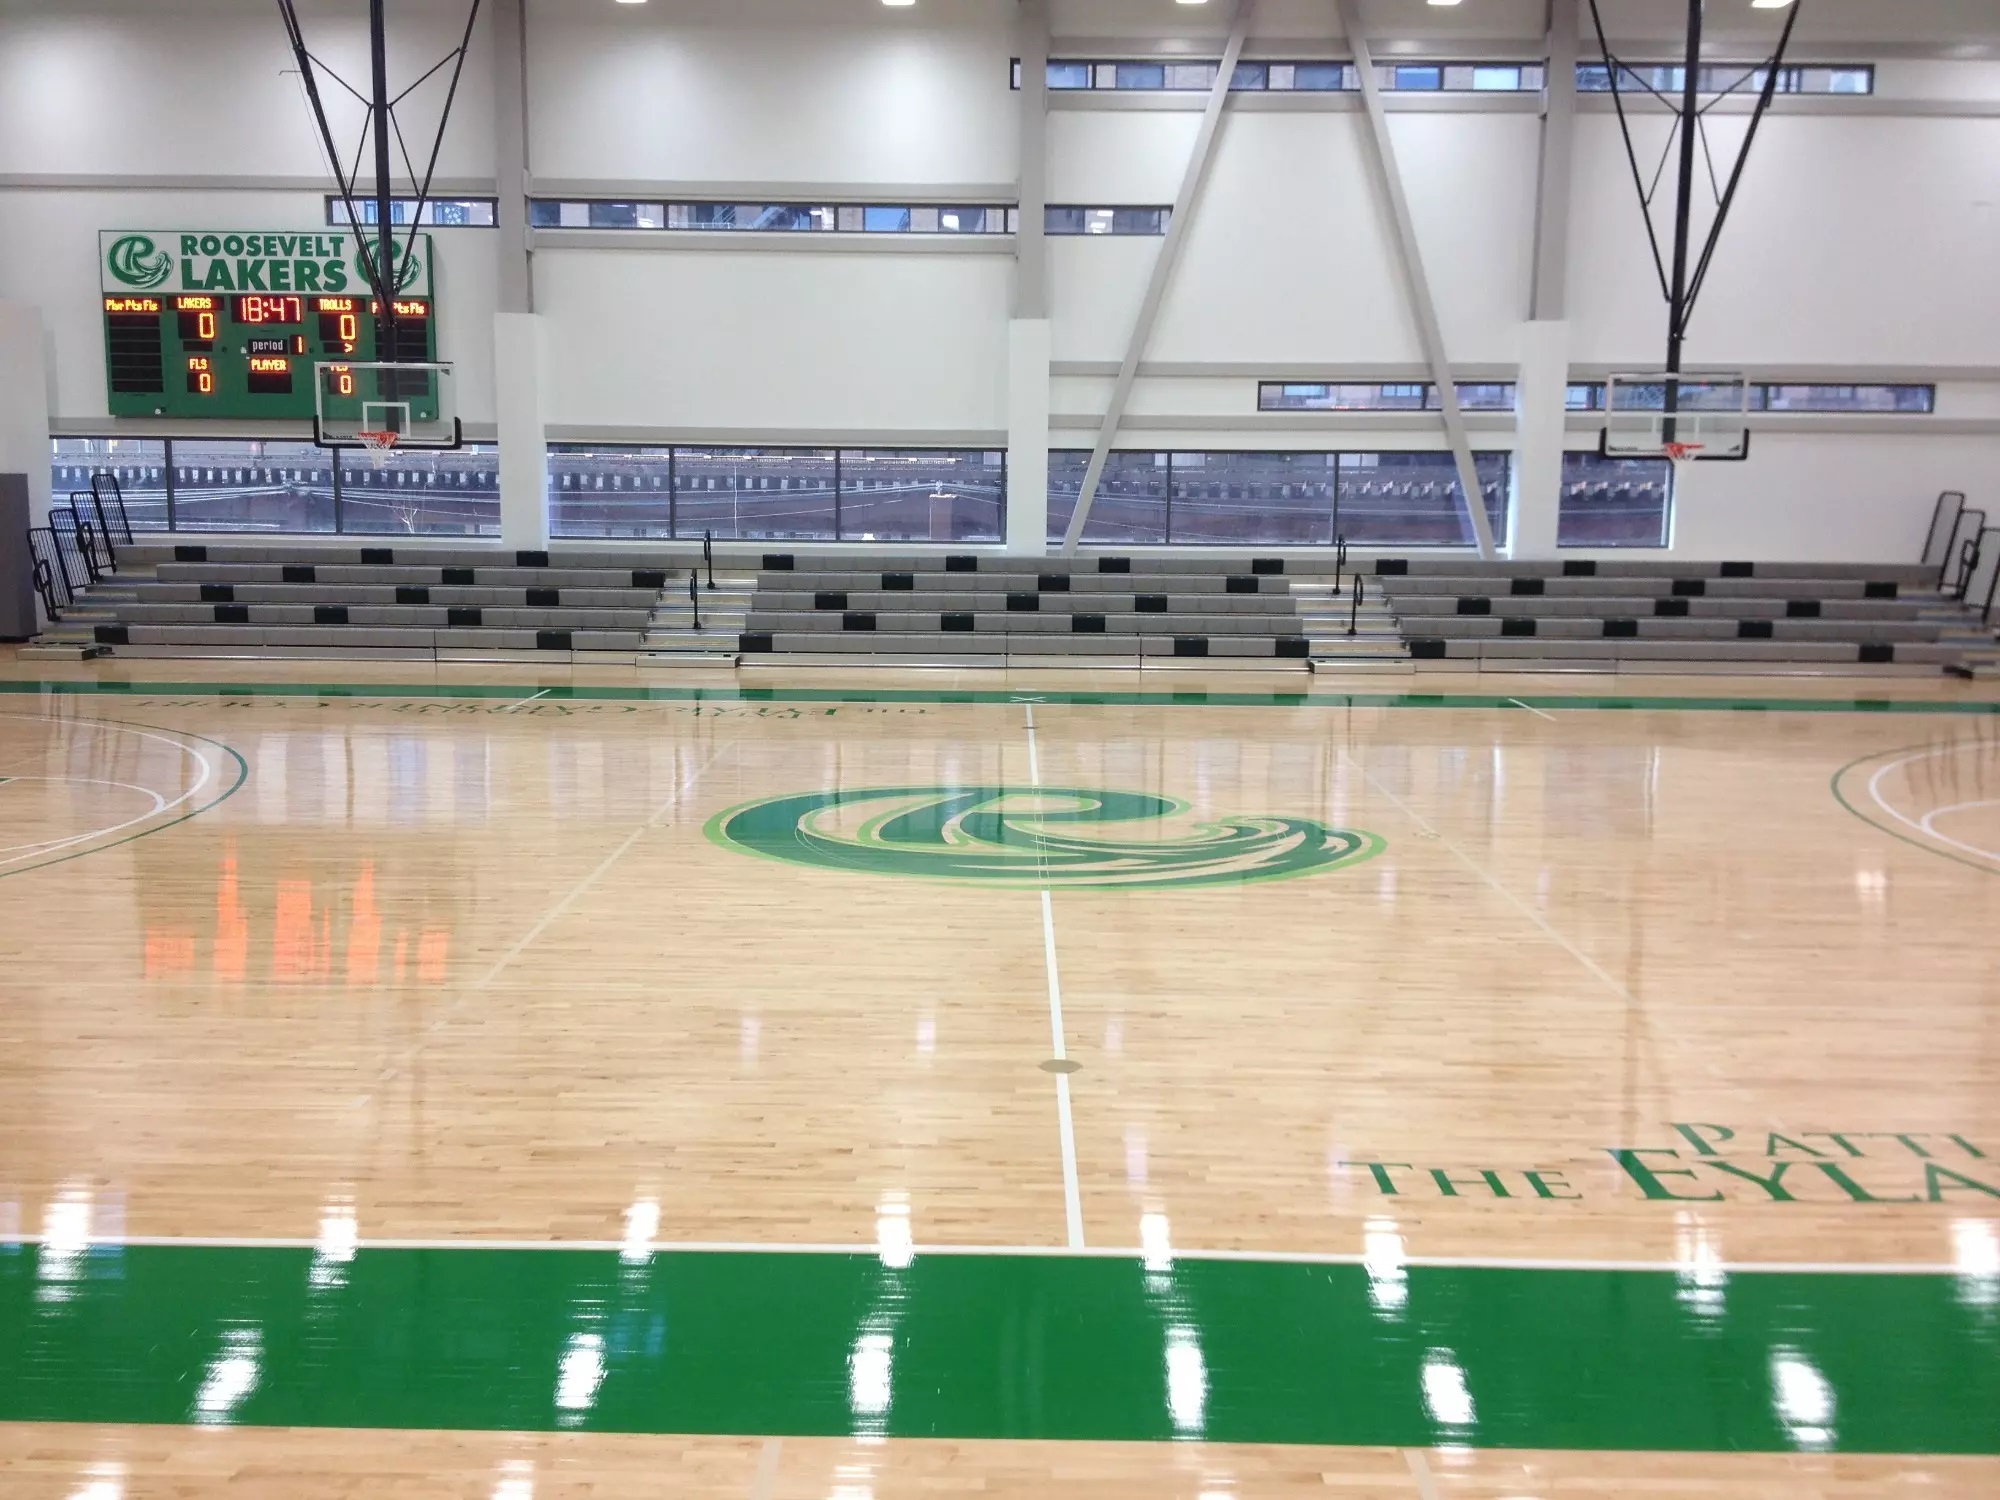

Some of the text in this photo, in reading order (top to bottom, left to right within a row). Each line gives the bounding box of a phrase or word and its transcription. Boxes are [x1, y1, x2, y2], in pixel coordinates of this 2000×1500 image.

[180, 235, 344, 257] ROOSEVELT
[181, 259, 348, 292] LAKERS
[177, 297, 211, 309] LAKERS
[242, 296, 301, 322] 18:47
[319, 298, 352, 311] TROLLS
[199, 313, 215, 339] 0
[340, 314, 356, 341] 0
[252, 339, 284, 351] period
[189, 359, 208, 370] FLS
[251, 360, 287, 371] PLAYER
[200, 373, 211, 392] 0
[340, 375, 351, 394] 0
[1665, 1122, 1987, 1157] PATTI
[1337, 1160, 1583, 1199] THE
